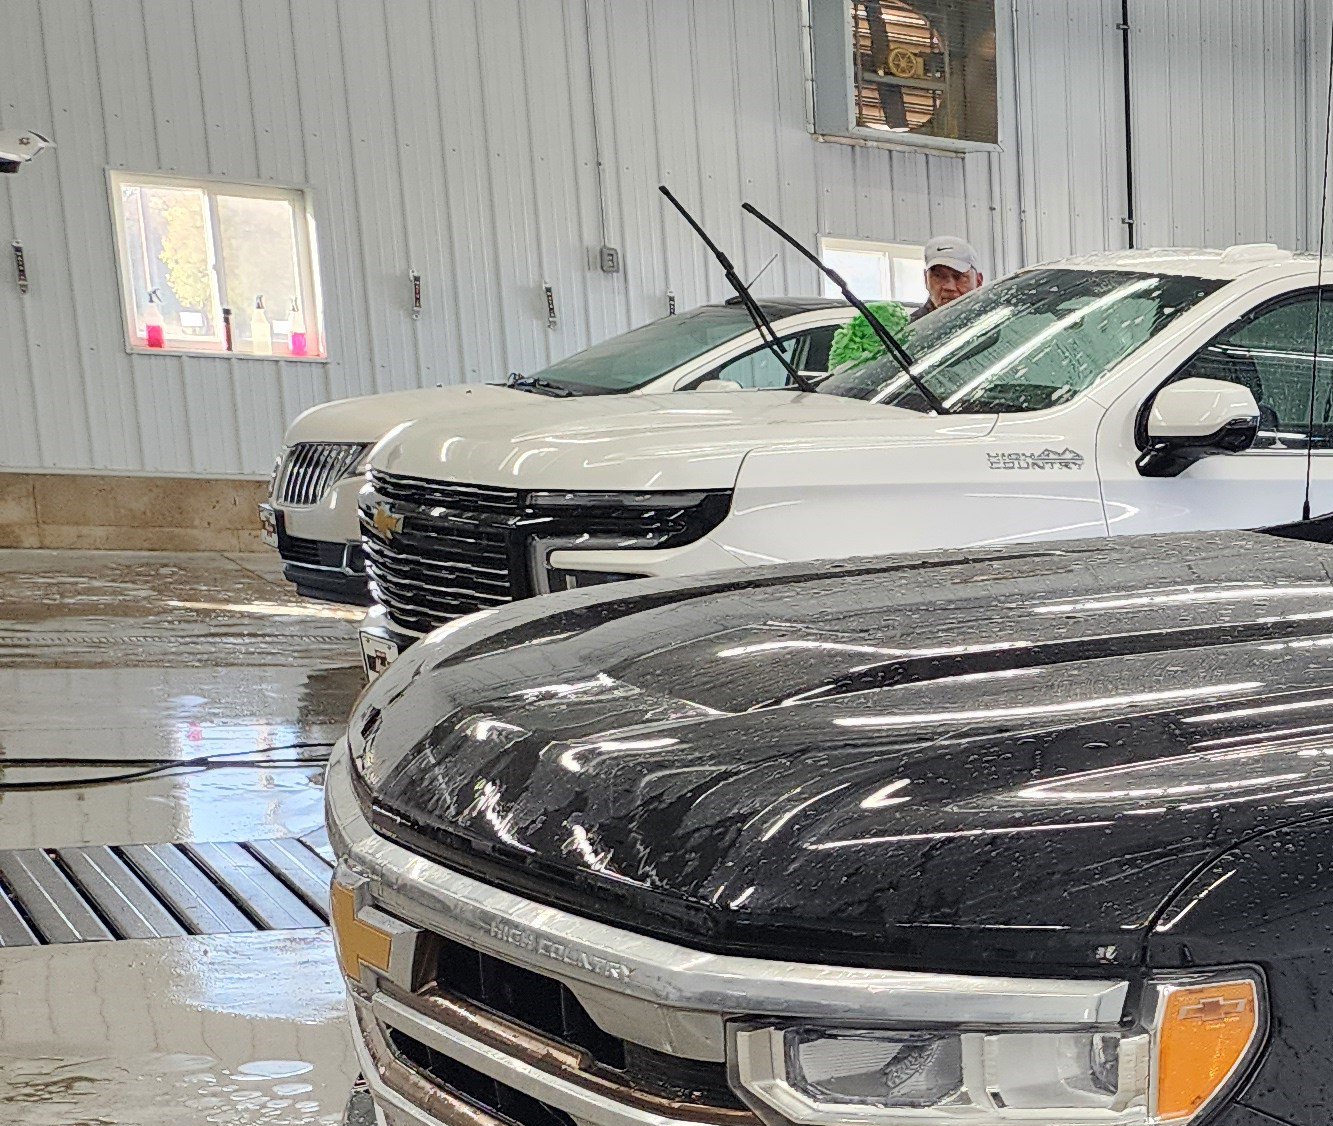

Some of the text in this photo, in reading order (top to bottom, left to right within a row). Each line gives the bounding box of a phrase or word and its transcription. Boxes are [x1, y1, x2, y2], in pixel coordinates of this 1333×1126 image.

[989, 461, 1085, 470] COUNTRY
[490, 921, 637, 983] HIGH COUNTRY
